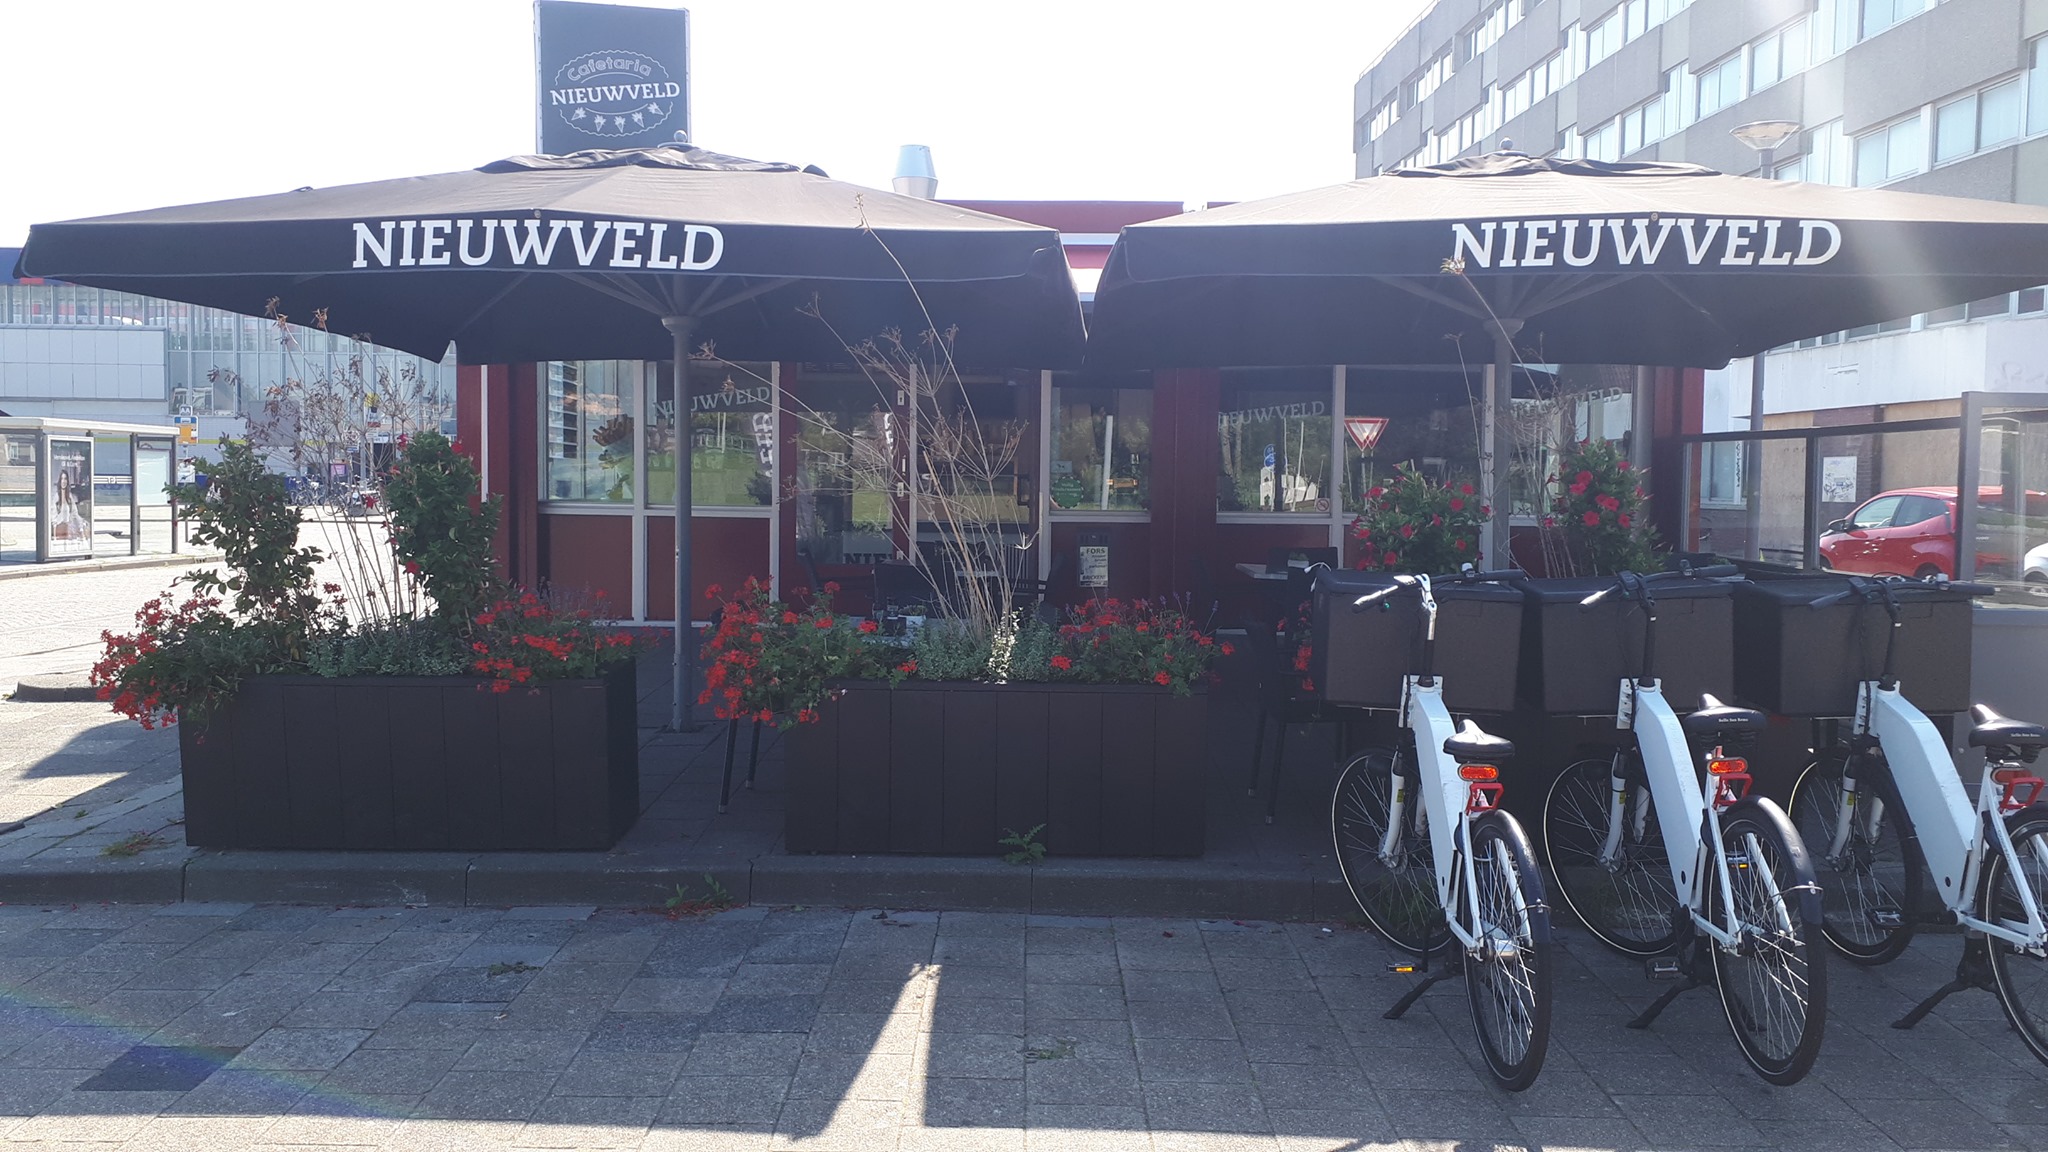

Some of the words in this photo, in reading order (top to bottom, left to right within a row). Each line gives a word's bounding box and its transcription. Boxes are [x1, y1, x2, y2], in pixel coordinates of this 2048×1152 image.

[567, 57, 651, 82] Cafetaria
[550, 82, 680, 106] NIEUWVELD
[352, 218, 724, 271] NIEUWVELD
[1451, 217, 1842, 268] NIEUWVELD
